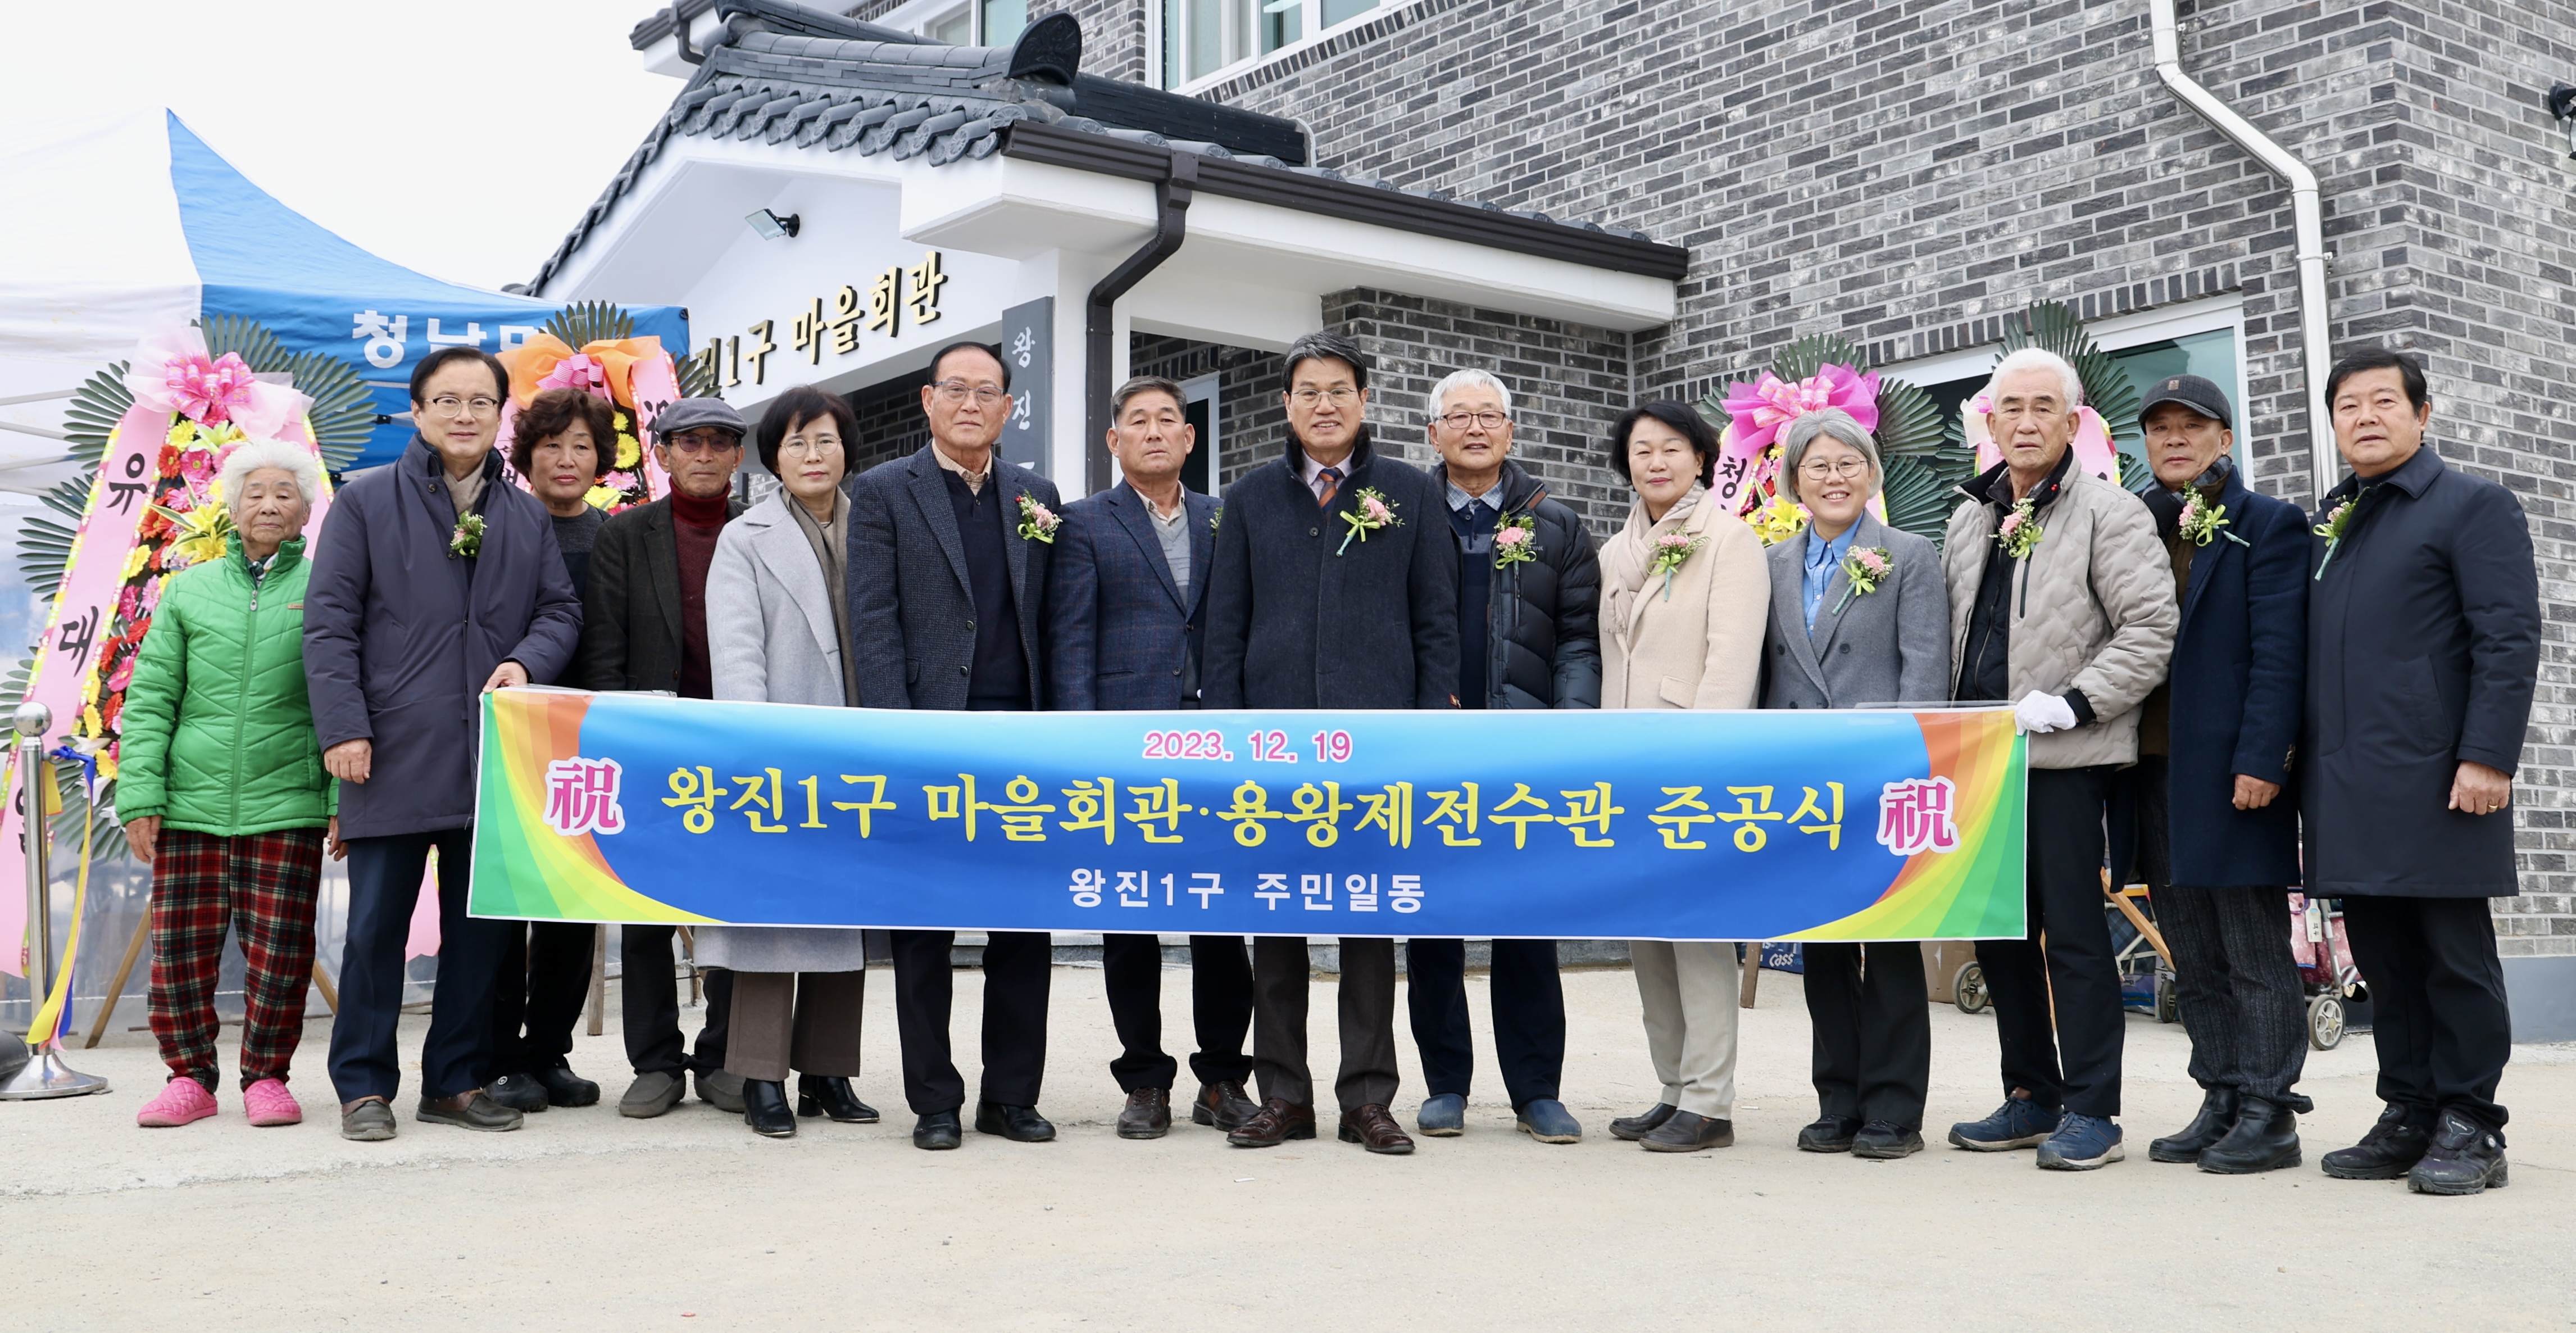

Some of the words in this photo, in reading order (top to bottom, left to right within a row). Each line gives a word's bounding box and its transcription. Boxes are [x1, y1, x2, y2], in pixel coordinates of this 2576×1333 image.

[352, 309, 548, 369] 청남
[790, 251, 948, 365] 마을회관
[1012, 327, 1035, 470] 왕진
[1718, 456, 1747, 510] 청
[1144, 731, 1232, 760] 2023.
[1250, 731, 1297, 761] 12.
[1312, 731, 1352, 762] 19
[546, 760, 621, 832] 祝
[661, 765, 897, 838] 왕진1구
[1648, 782, 1844, 853] 준공식
[1879, 779, 1957, 853] 祝
[1069, 868, 1224, 909] 왕진1구
[1254, 873, 1425, 913] 주민일동
